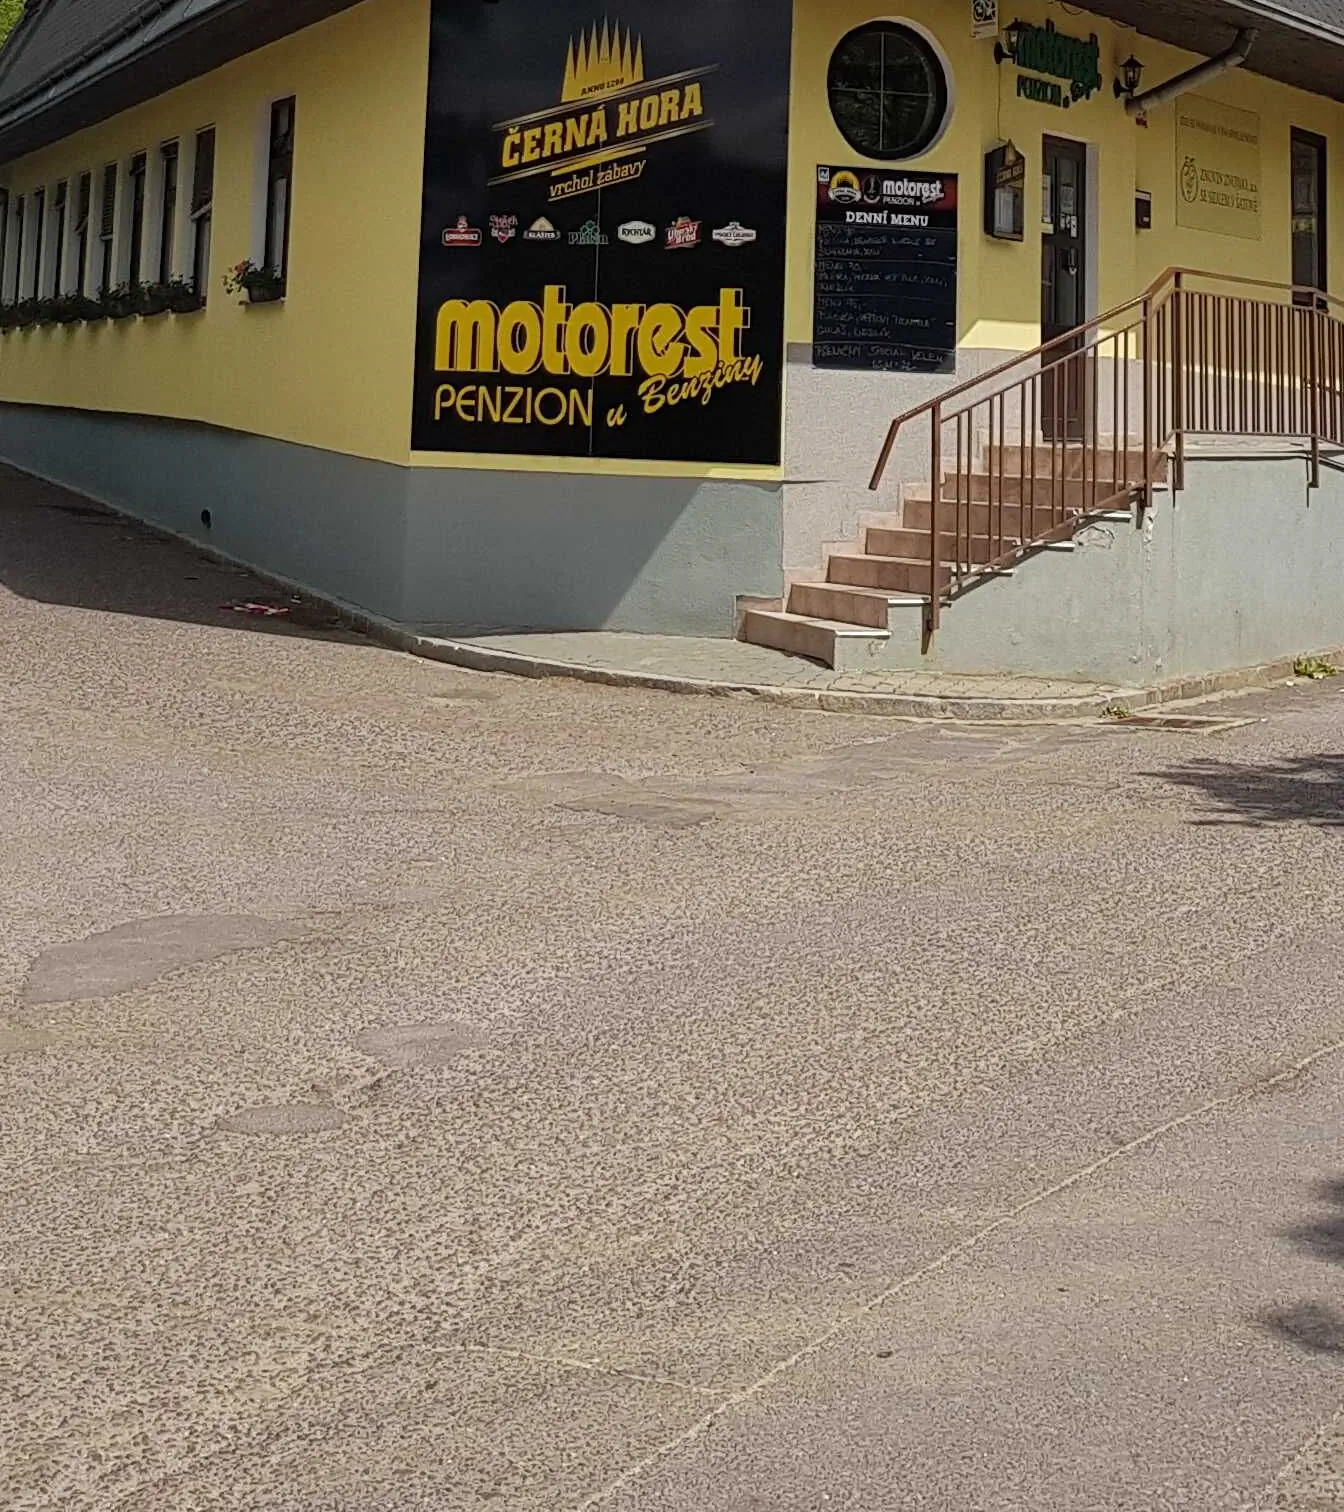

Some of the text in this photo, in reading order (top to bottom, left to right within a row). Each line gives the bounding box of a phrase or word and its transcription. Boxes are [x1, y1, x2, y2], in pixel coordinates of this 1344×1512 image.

[502, 83, 703, 168] ČERNÁ HORA
[550, 159, 646, 197] vrchol zábavy
[882, 177, 943, 197] motorest
[846, 210, 929, 226] DENNÍ MENU
[435, 285, 751, 377] motorest
[434, 353, 763, 427] PENZION u Benziny
